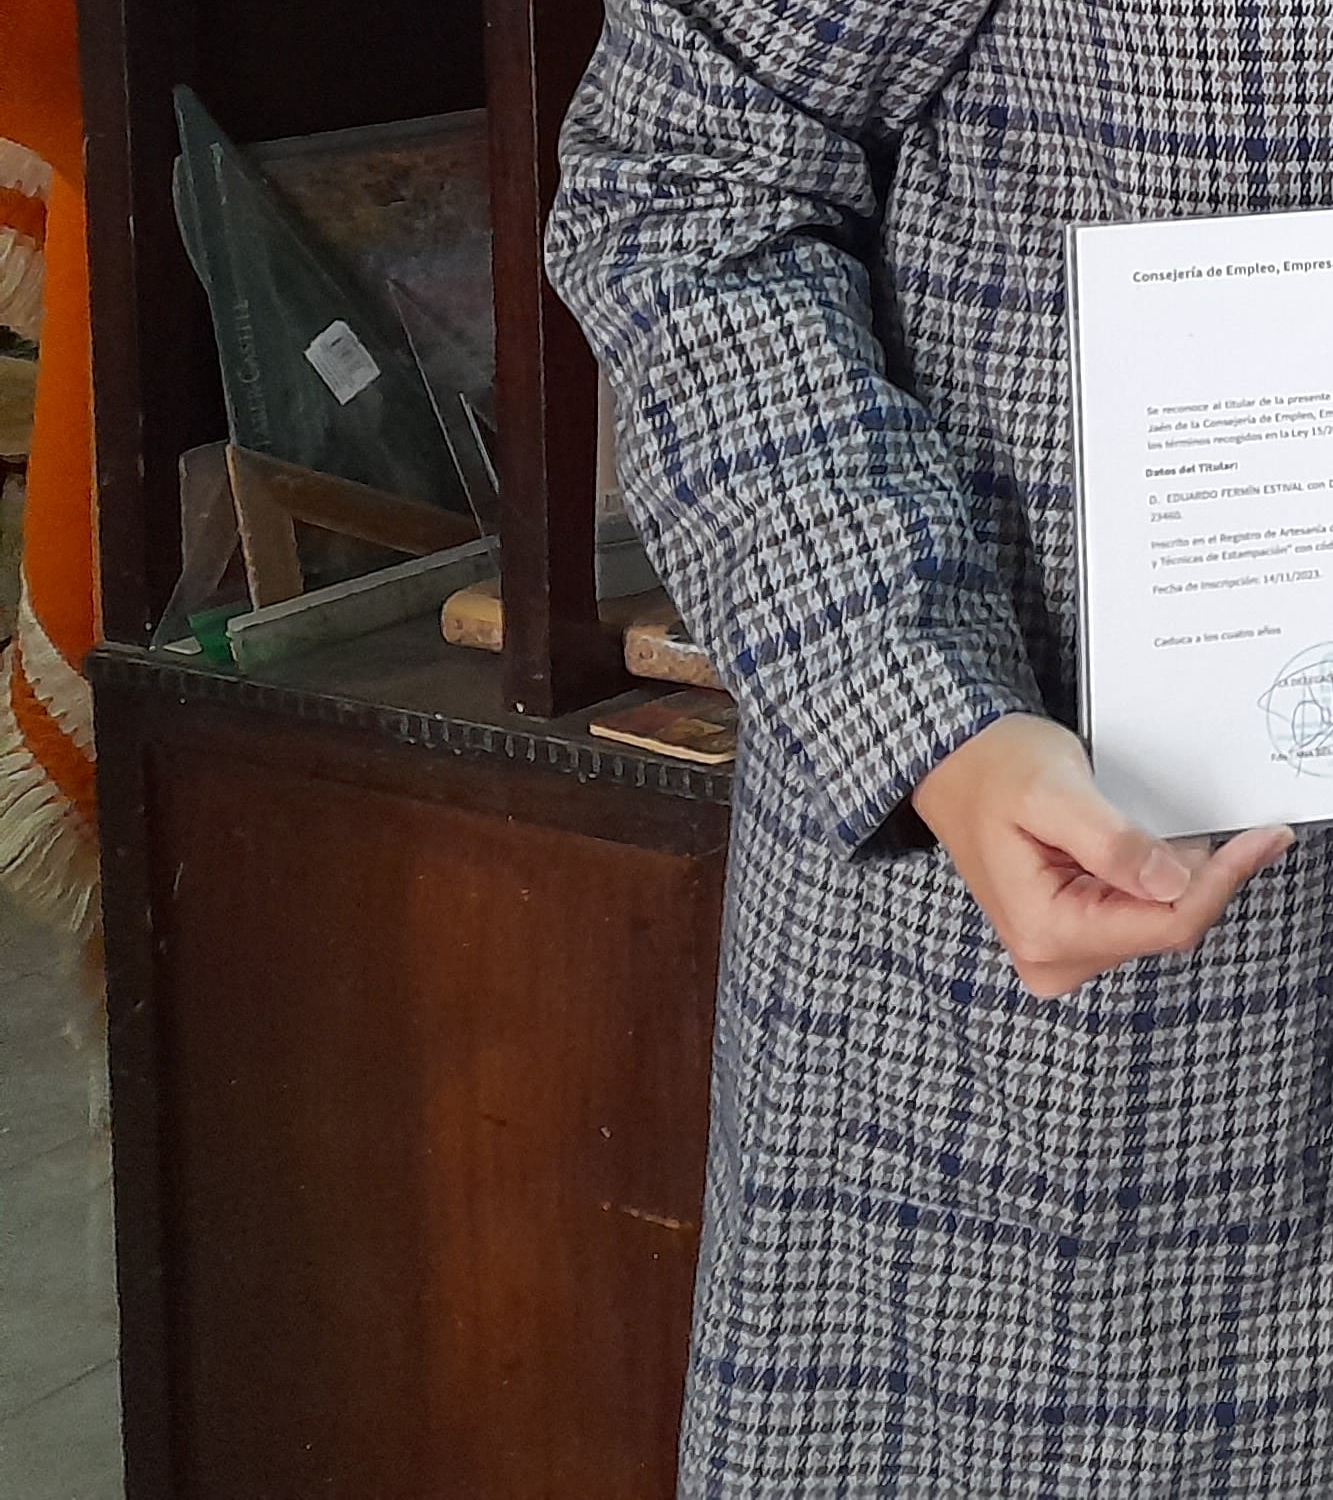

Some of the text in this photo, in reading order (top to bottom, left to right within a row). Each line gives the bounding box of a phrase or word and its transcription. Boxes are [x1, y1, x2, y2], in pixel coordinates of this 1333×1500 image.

[1131, 265, 1204, 284] Consejería
[1205, 265, 1223, 278] de
[1224, 262, 1281, 278] Empleo,
